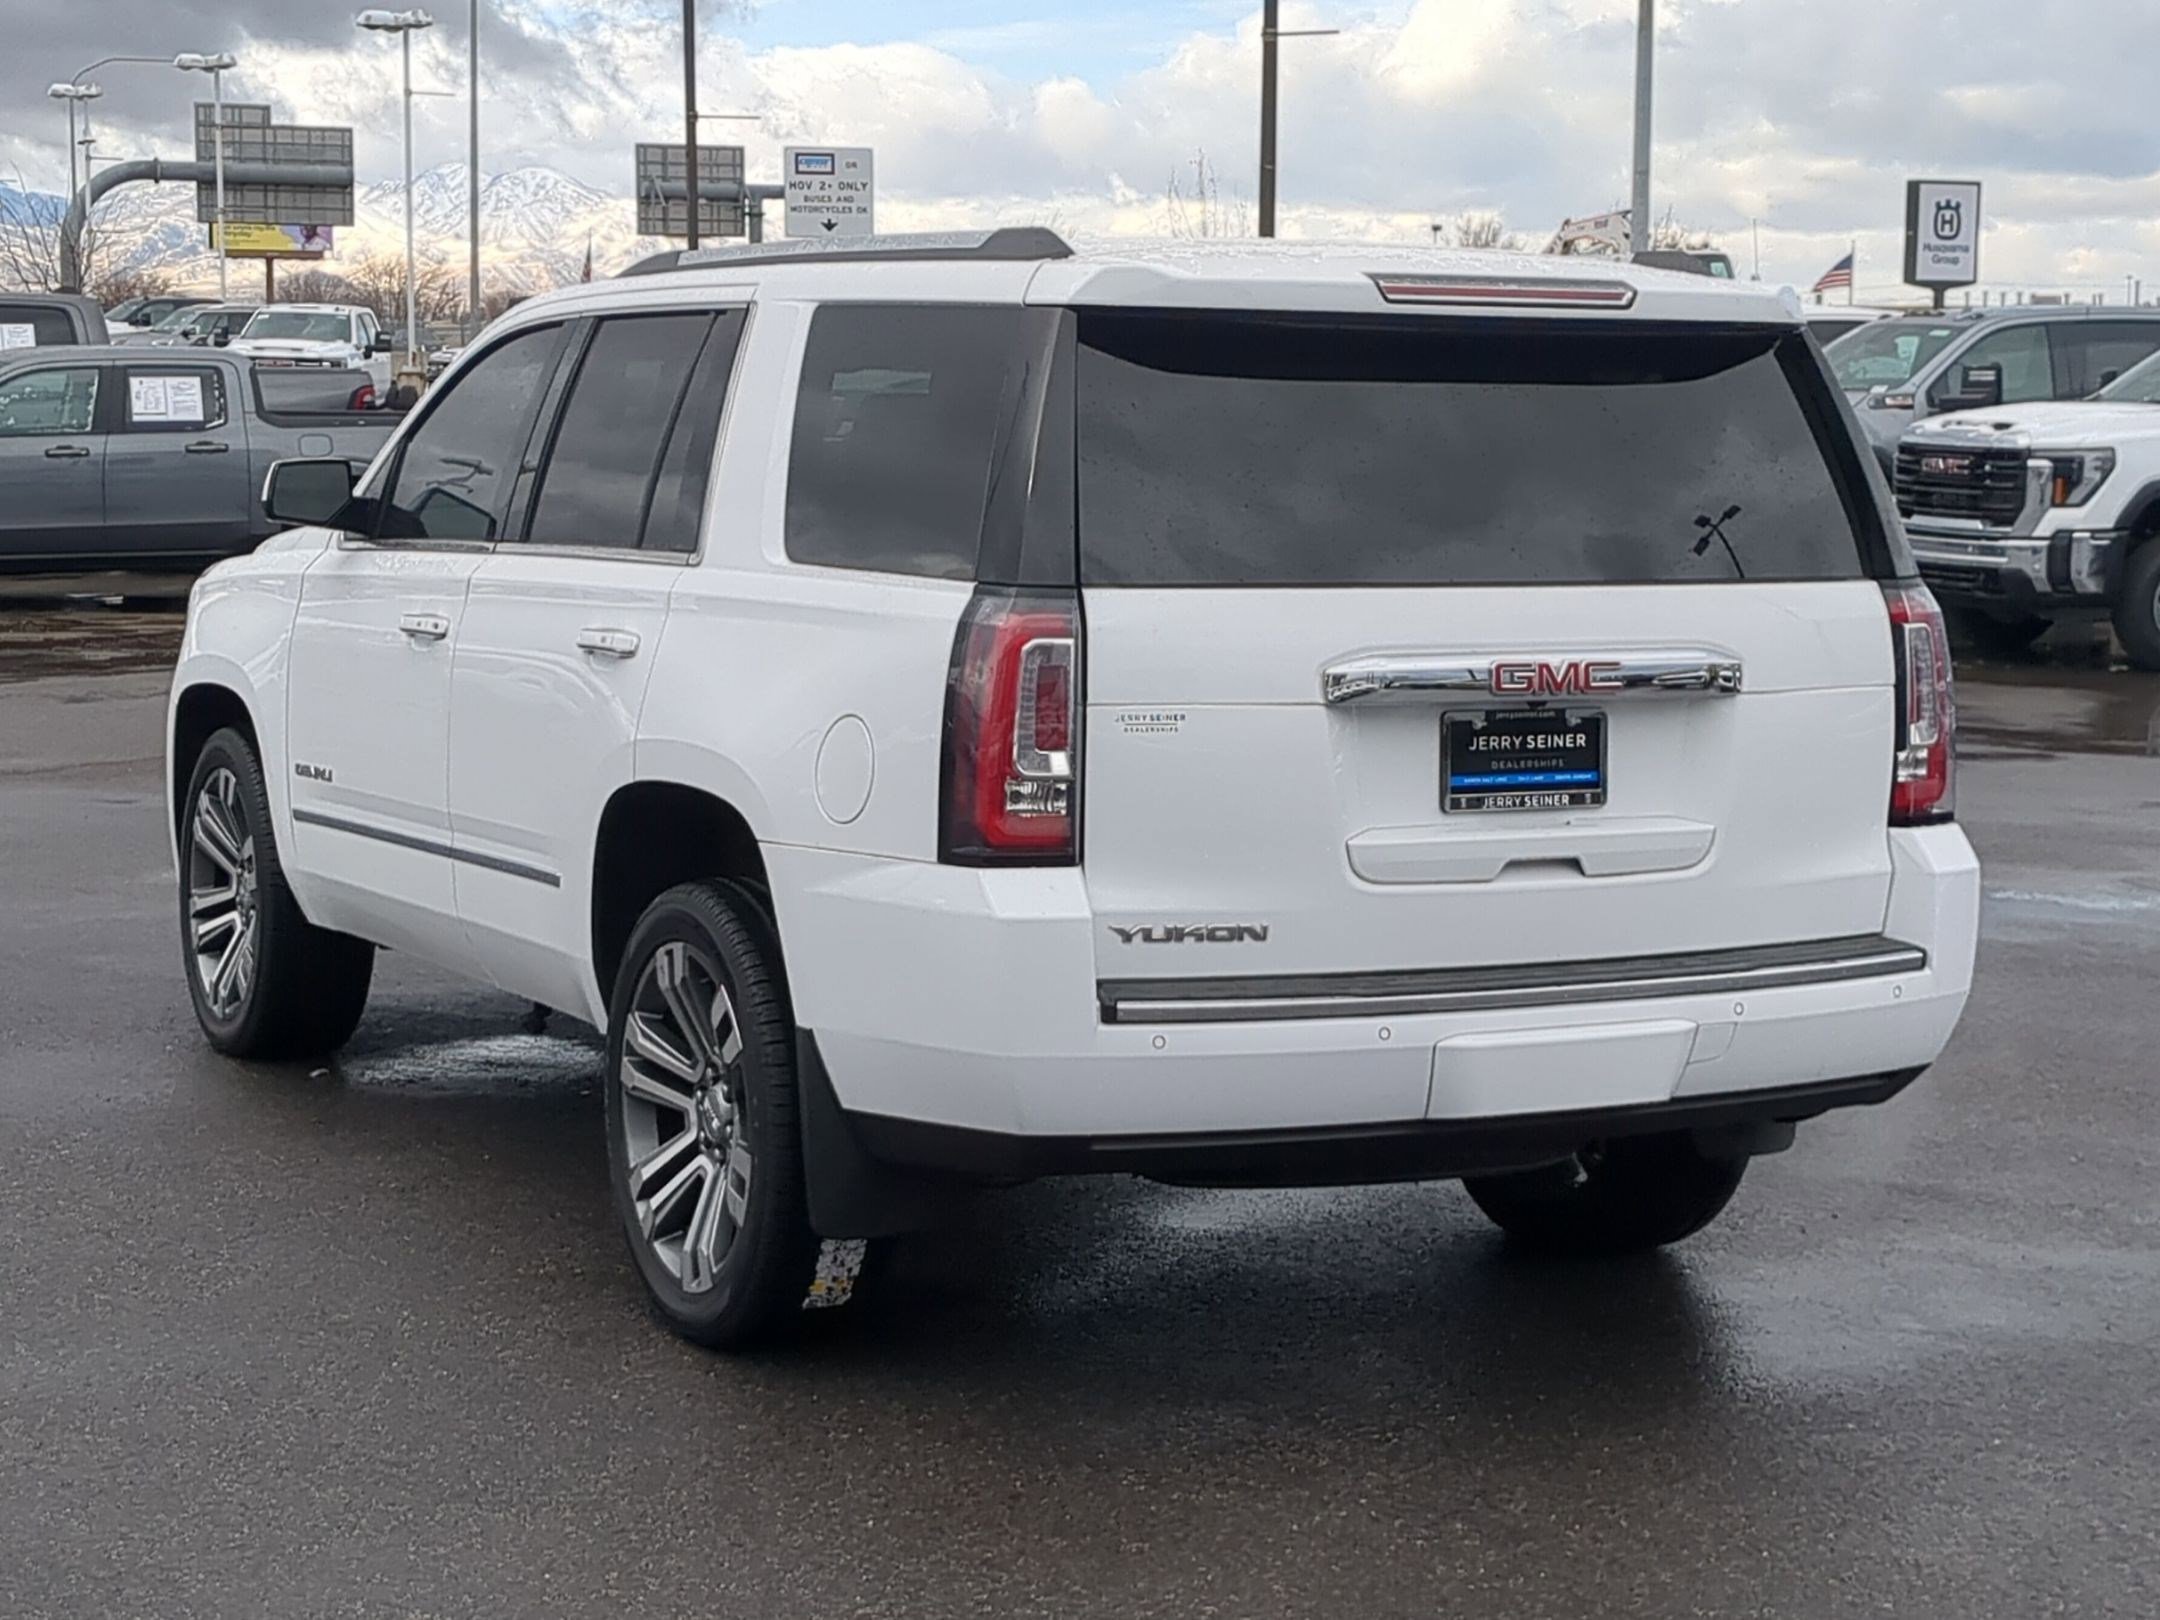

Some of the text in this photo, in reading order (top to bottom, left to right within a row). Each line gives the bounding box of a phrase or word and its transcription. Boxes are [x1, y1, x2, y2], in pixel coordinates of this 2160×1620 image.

[789, 181, 812, 190] HOV
[838, 181, 868, 191] ONLY
[803, 195, 855, 203] BUSES AND
[790, 205, 868, 214] MOTORCYCLES OK
[1922, 242, 1969, 254] Husqvarna
[1931, 253, 1960, 266] Group
[1490, 660, 1624, 695] GMC
[1114, 713, 1186, 723] JERRY SEINER
[1469, 733, 1587, 751] JERRY SEINER
[1491, 758, 1565, 769] DEALERSHIPS
[1483, 794, 1570, 809] JERRY SEINER
[1108, 924, 1270, 944] YUKON
